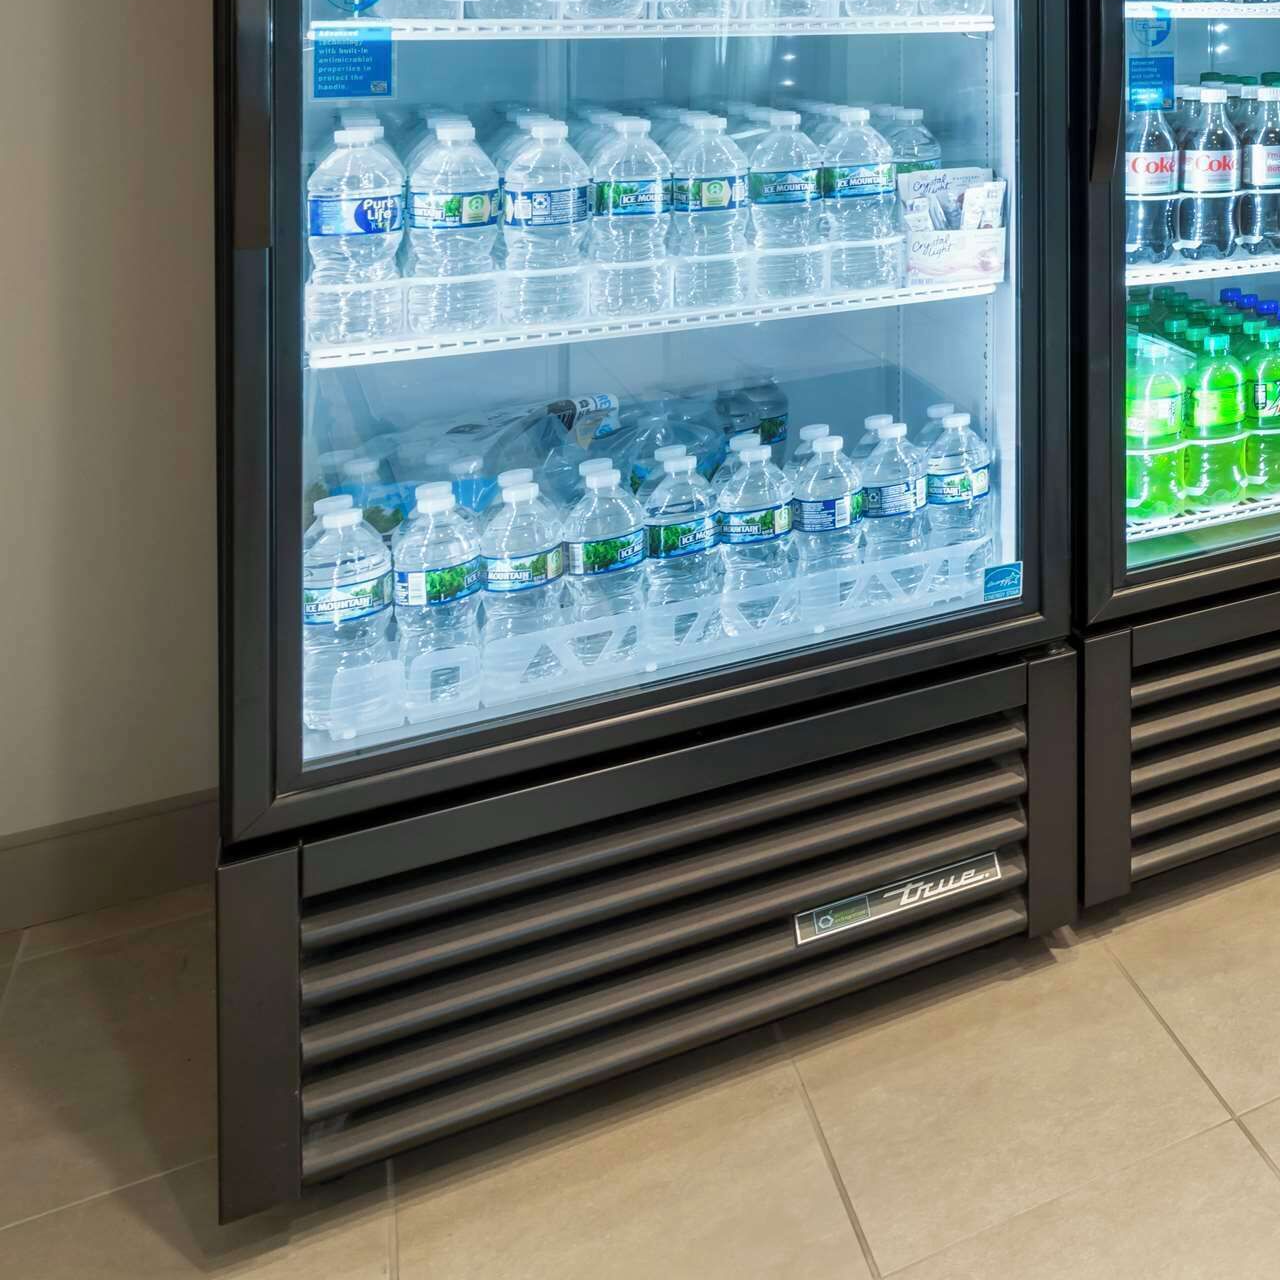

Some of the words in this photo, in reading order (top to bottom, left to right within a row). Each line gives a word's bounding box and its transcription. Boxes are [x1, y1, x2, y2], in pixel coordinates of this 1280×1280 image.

[837, 178, 849, 188] ICE
[764, 185, 776, 194] ICE
[363, 198, 394, 211] Pure
[622, 195, 637, 205] ICE
[366, 208, 392, 221] Life
[681, 534, 696, 546] ICE
[305, 602, 318, 614] ICE
[318, 596, 372, 612] MOUNTAIN
